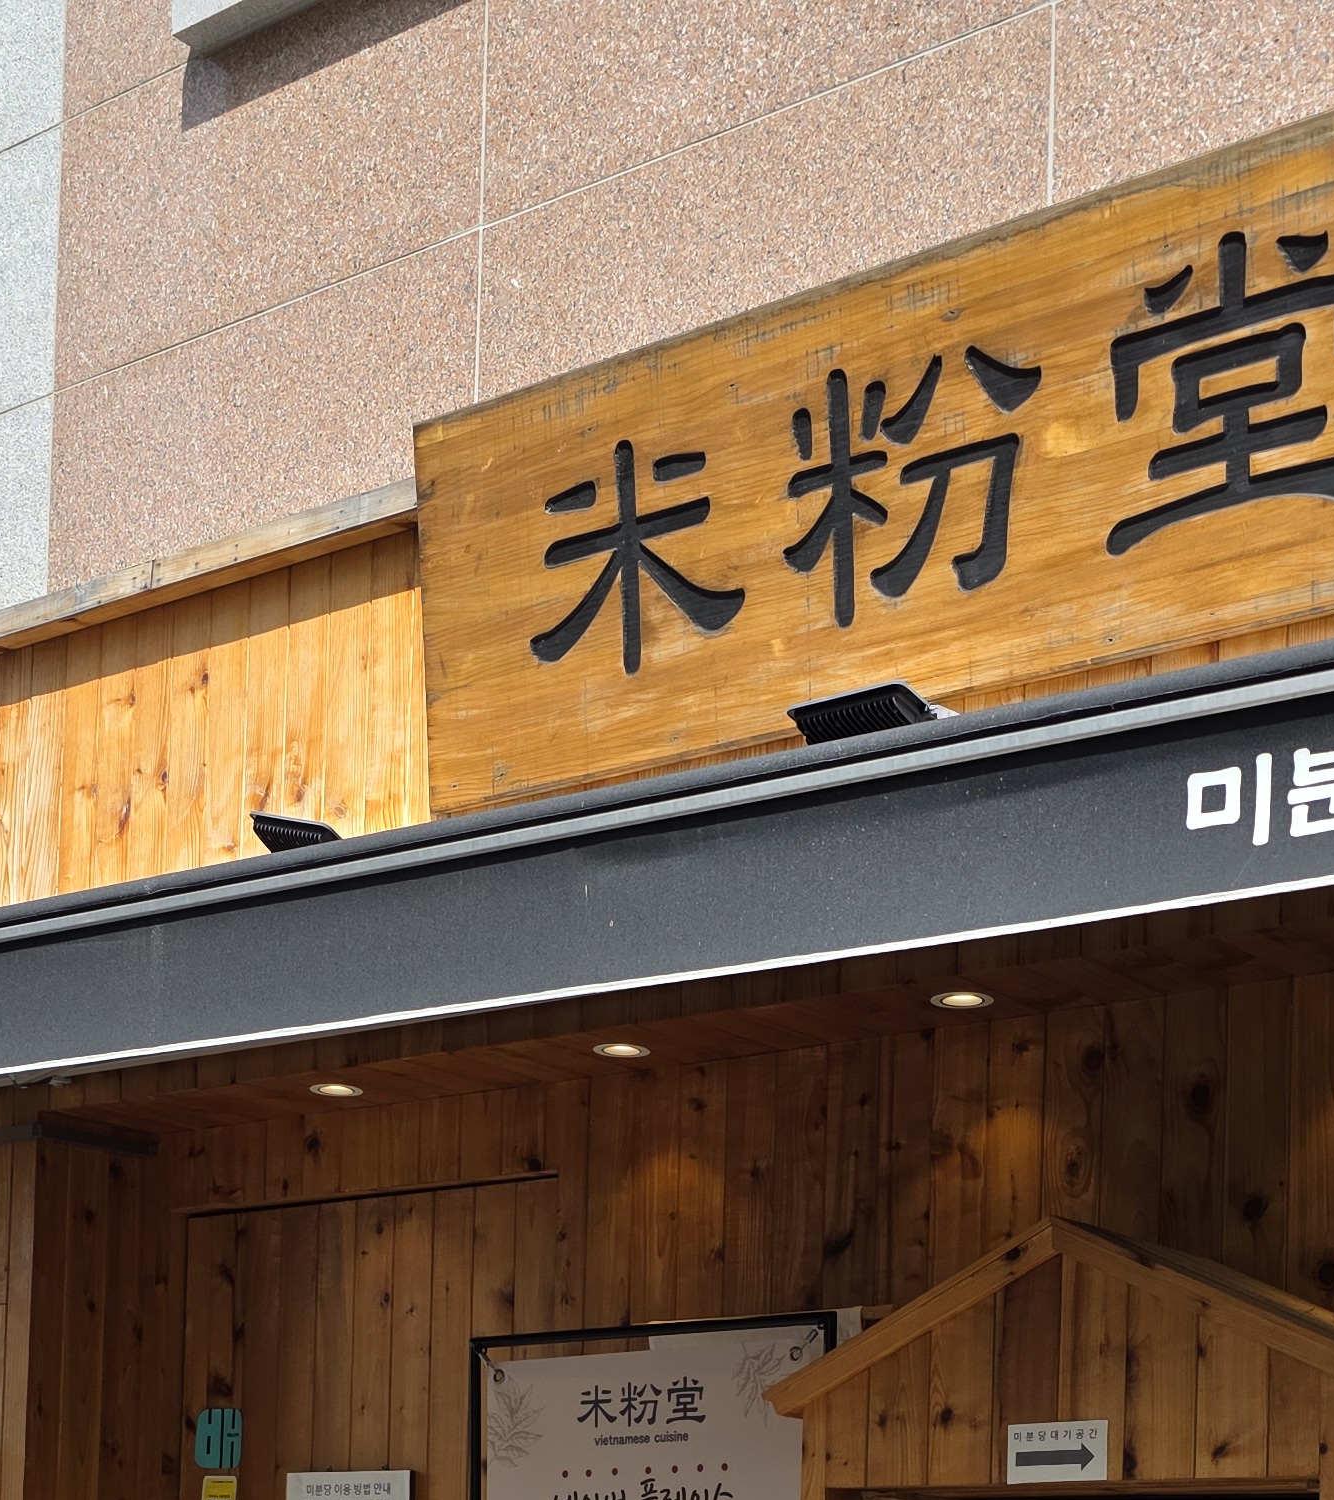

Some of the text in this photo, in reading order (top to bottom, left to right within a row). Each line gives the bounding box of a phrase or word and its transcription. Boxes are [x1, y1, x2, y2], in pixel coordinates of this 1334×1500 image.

[576, 1376, 707, 1428] 米粉堂
[593, 1431, 689, 1447] vietnamese cuisine
[306, 1482, 391, 1496] 미분당 이용 방법 안내
